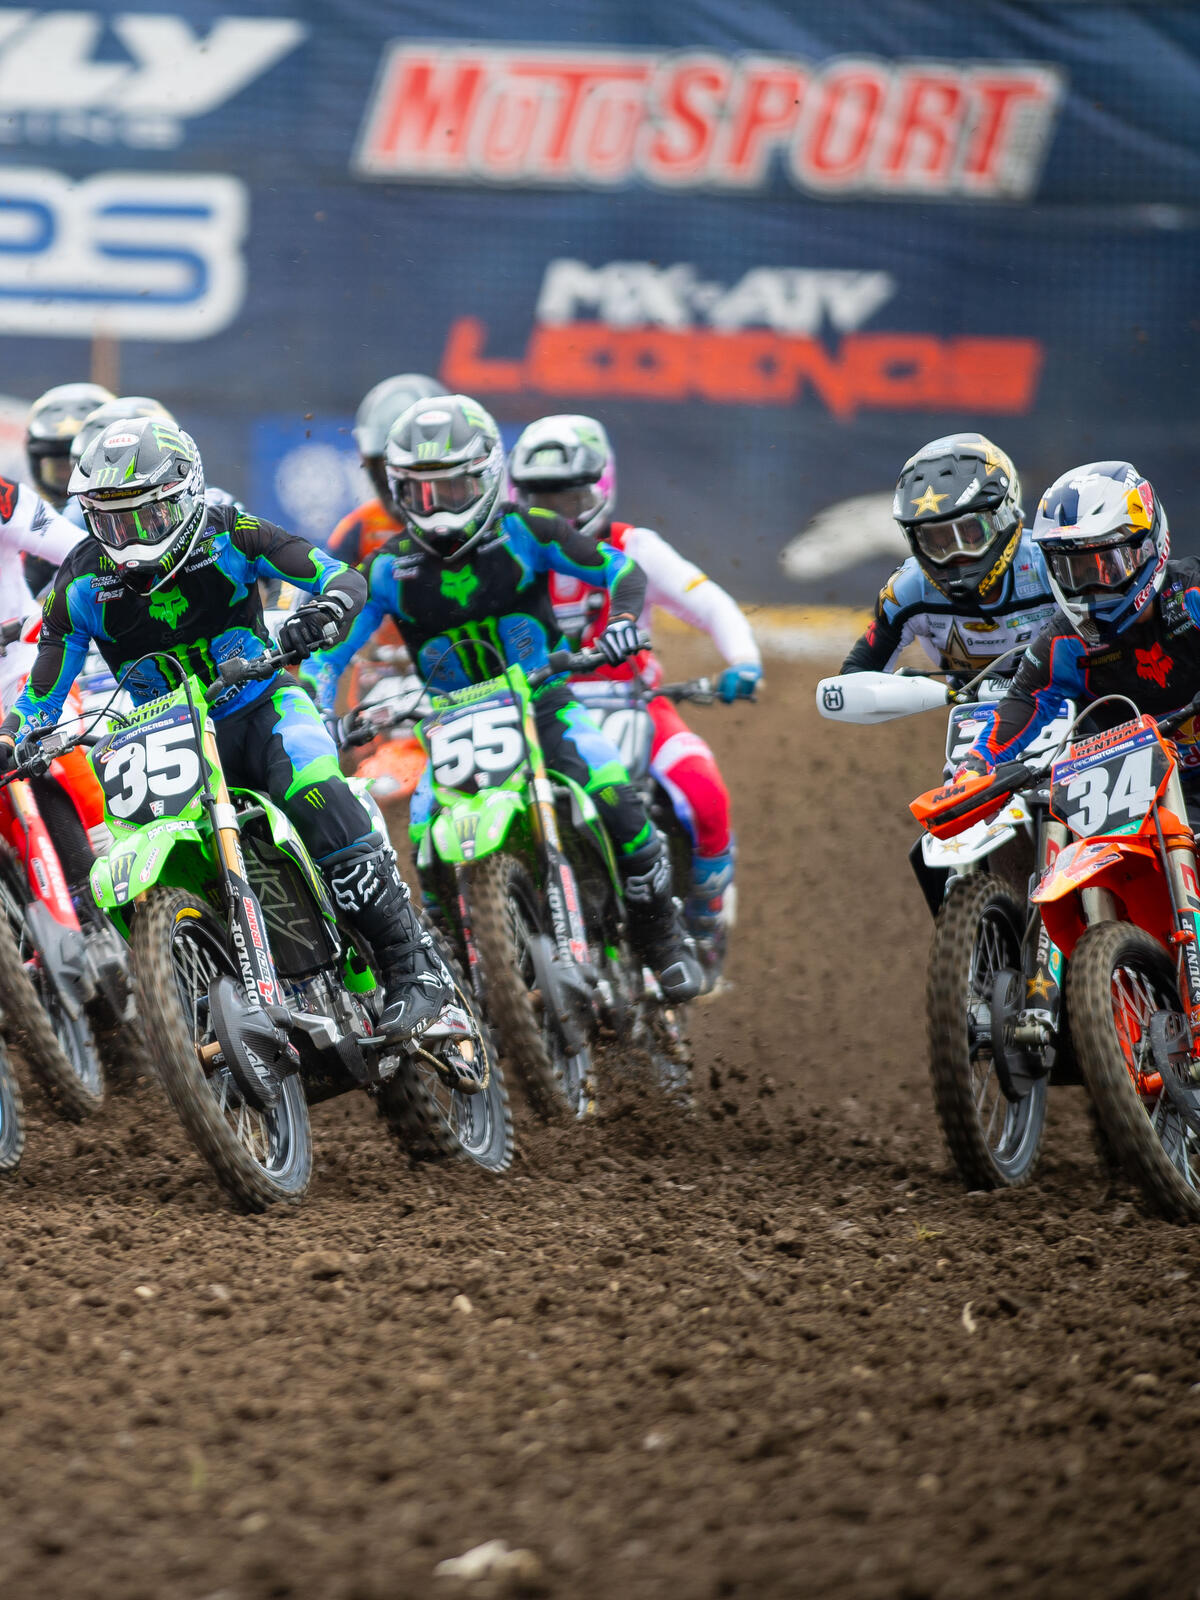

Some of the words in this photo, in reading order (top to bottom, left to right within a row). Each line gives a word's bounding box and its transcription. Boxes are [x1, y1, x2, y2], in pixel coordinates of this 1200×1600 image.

[110, 718, 175, 748] PROMOTOCROSS
[430, 705, 525, 787] 55
[1073, 740, 1135, 769] PROMOTOCROSS
[104, 722, 200, 818] 35
[933, 784, 966, 803] KTM
[1066, 746, 1157, 838] 34
[243, 896, 264, 949] BRAKING
[1180, 917, 1200, 990] DUNLP
